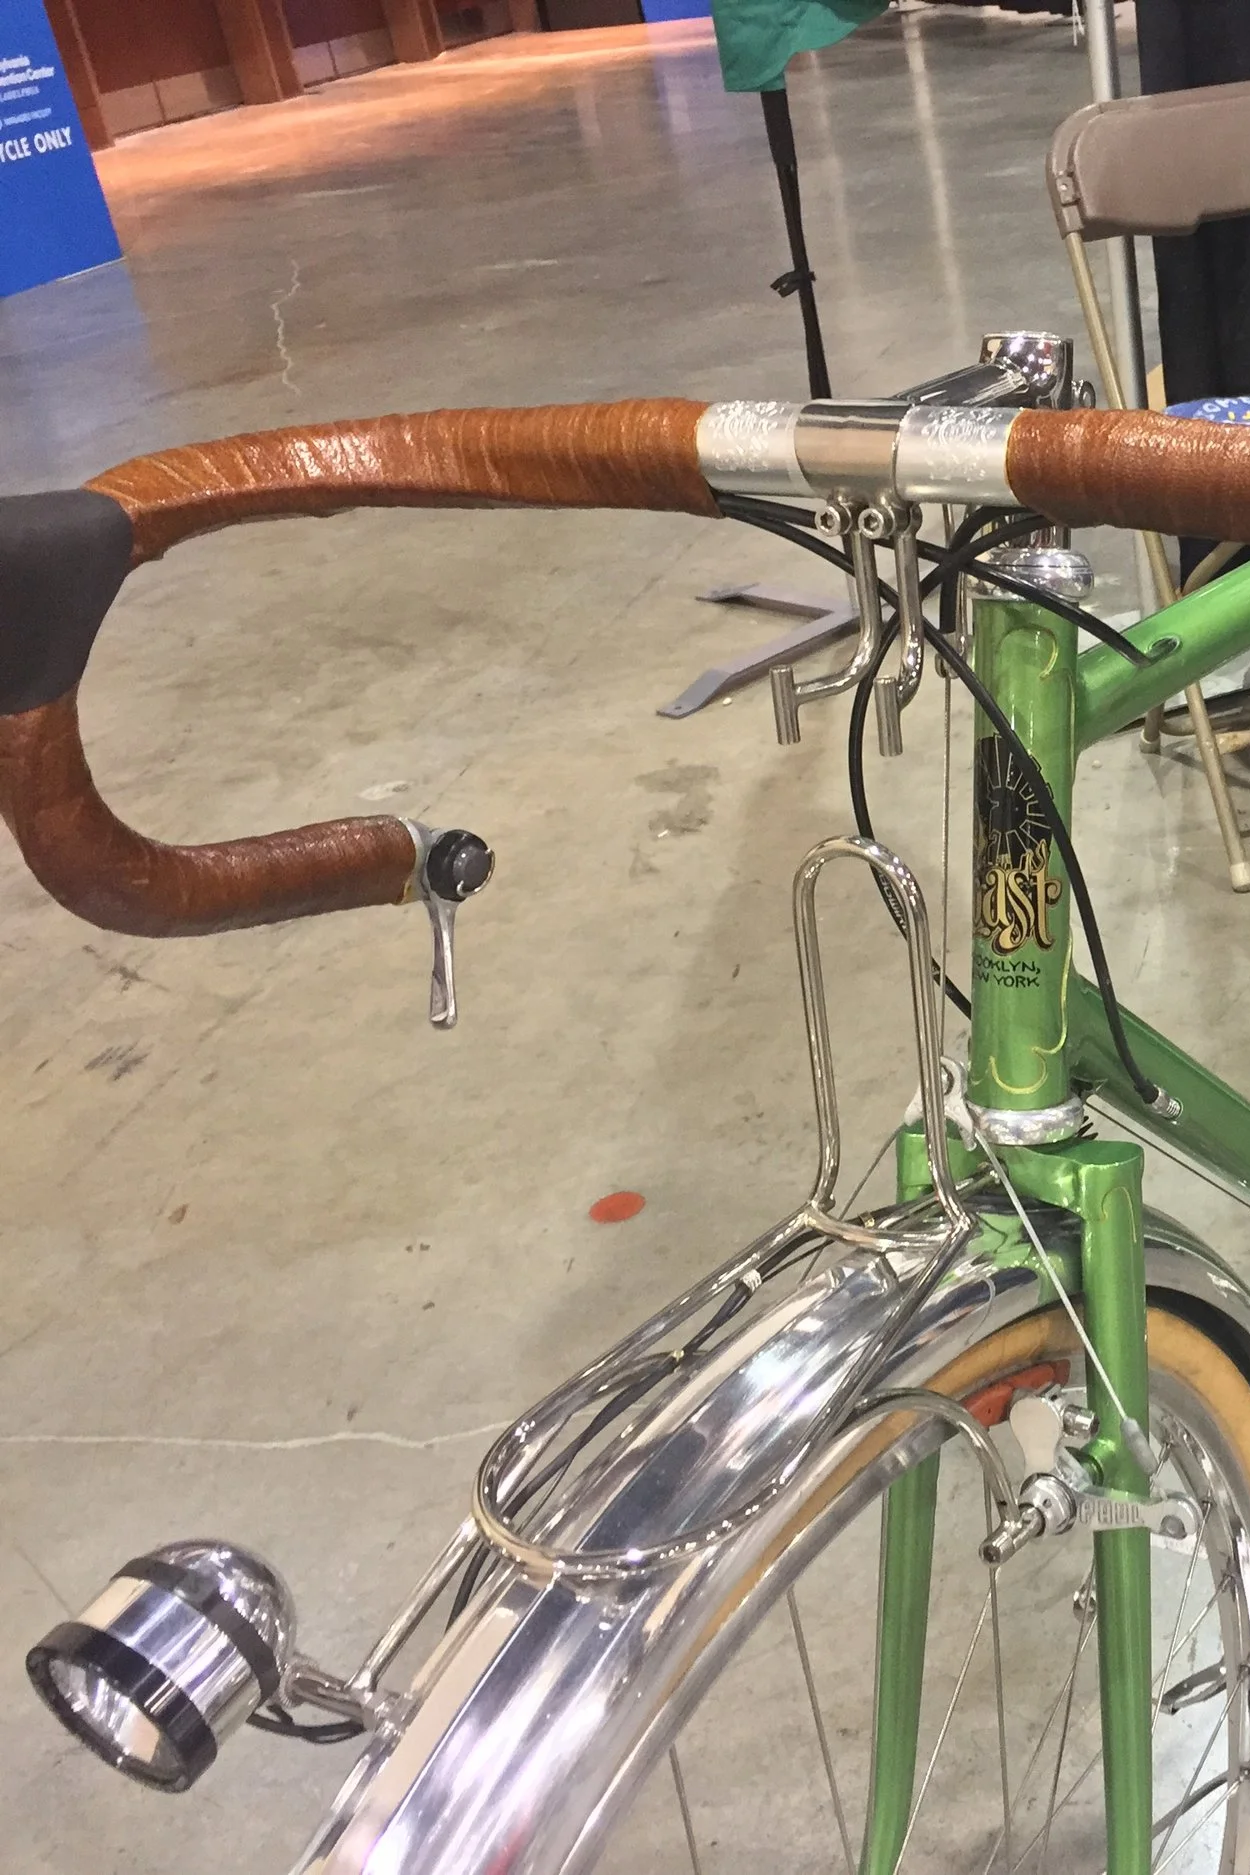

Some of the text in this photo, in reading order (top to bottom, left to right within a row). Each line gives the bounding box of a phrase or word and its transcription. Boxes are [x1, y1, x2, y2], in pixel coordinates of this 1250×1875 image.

[33, 126, 73, 154] ONLY
[993, 974, 1041, 988] YORK
[1078, 1500, 1145, 1525] PAUL
